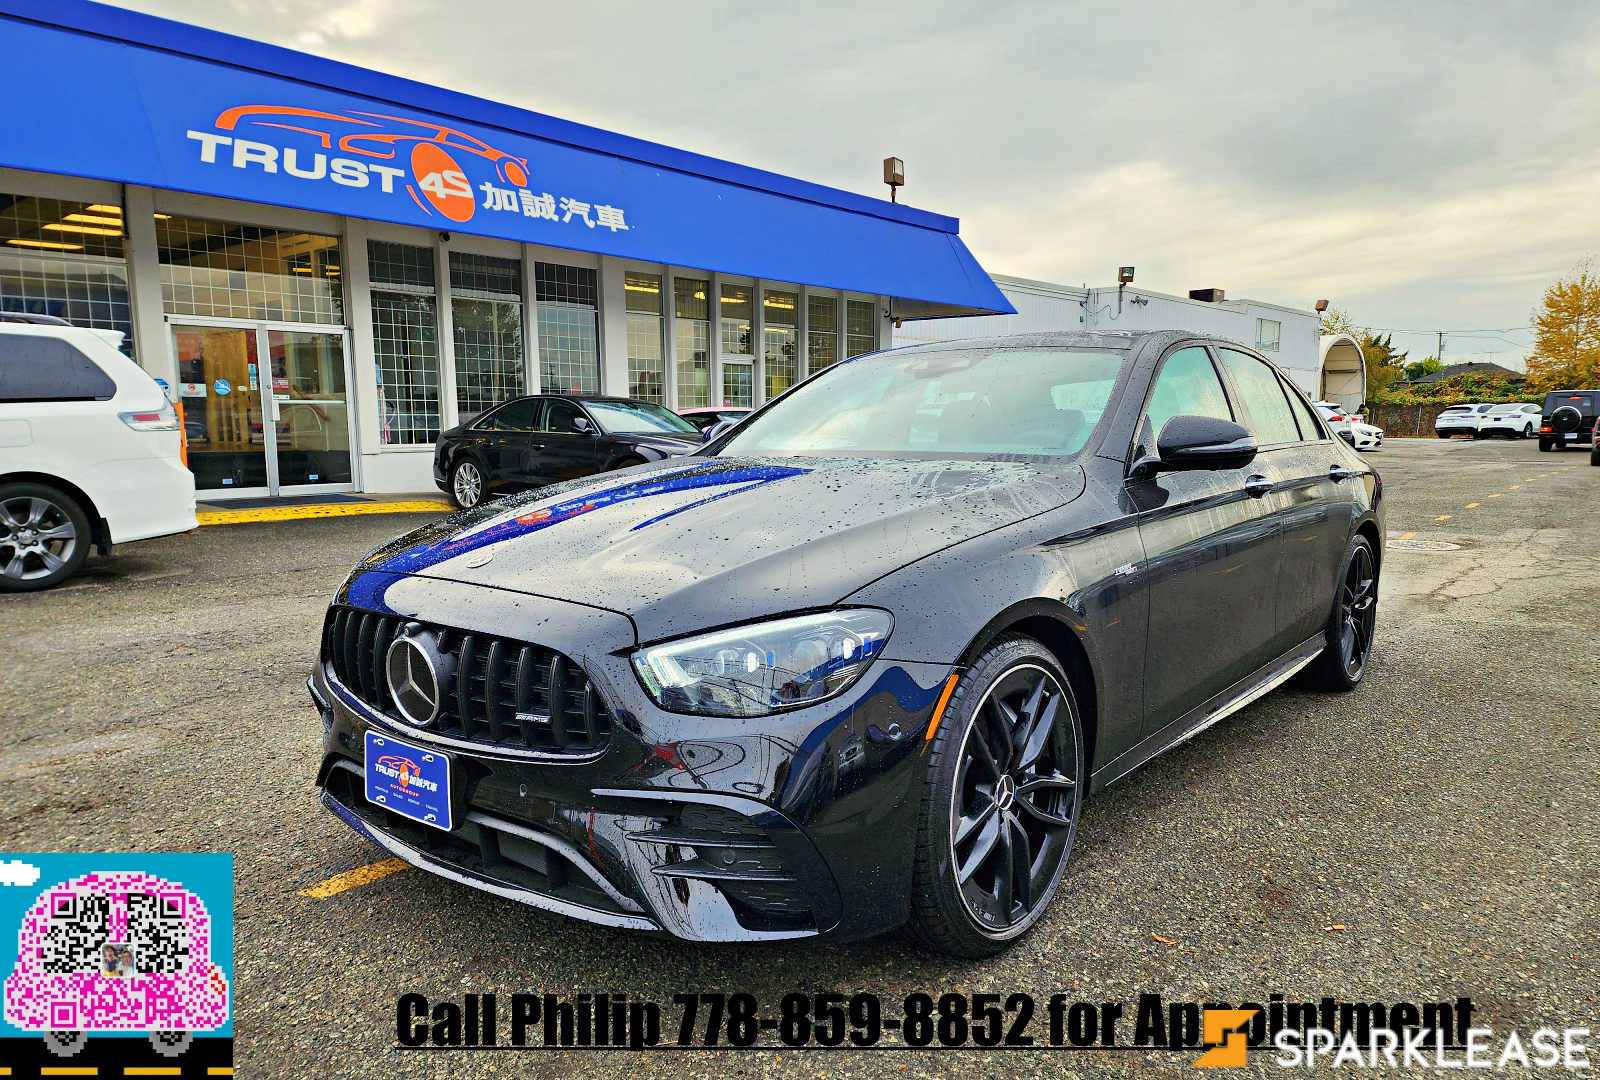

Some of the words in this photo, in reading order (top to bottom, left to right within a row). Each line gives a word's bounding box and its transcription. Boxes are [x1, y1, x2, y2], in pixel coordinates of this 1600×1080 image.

[187, 130, 405, 193] TRUST
[418, 168, 471, 200] 4S
[479, 181, 629, 233] 加誠汽車
[375, 763, 399, 779] TRUST
